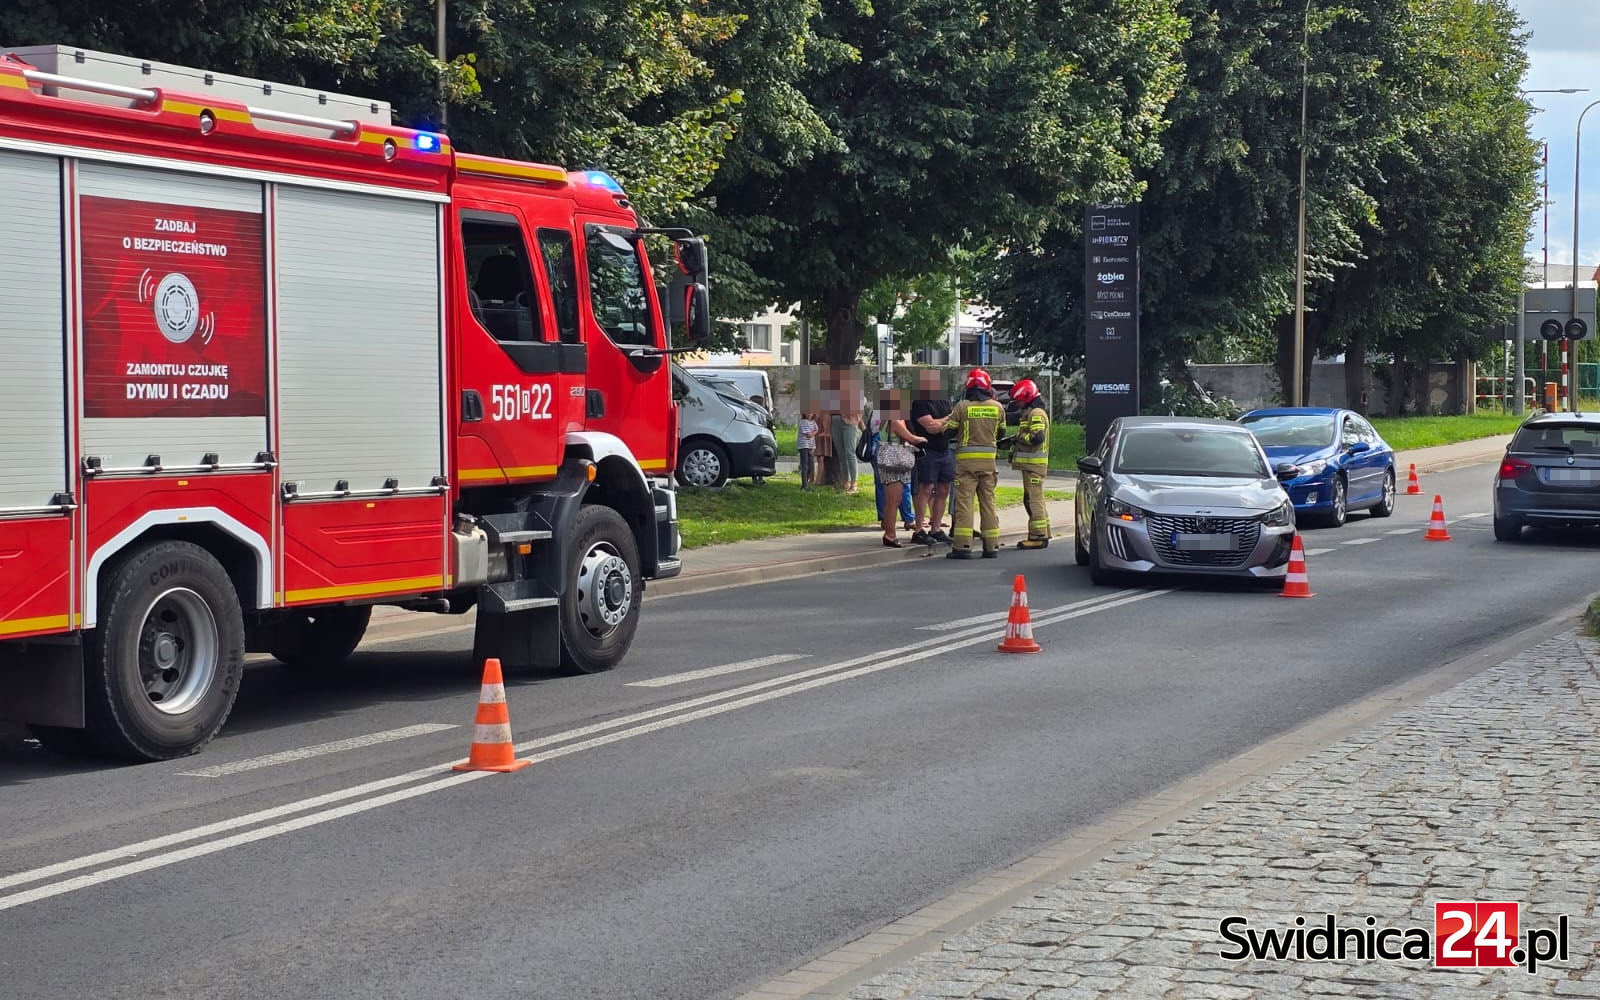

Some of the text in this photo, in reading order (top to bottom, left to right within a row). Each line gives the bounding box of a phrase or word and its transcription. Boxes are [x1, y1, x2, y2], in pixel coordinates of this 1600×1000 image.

[155, 218, 196, 234] ZADBAJ
[123, 236, 227, 257] O BEZPIECZEŃSTWO
[1096, 272, 1125, 281] żabka
[126, 363, 228, 380] ZAMONTUJ CZUJKĘ
[126, 383, 229, 400] DYMU I CZADU
[1091, 383, 1131, 391] AWESOME
